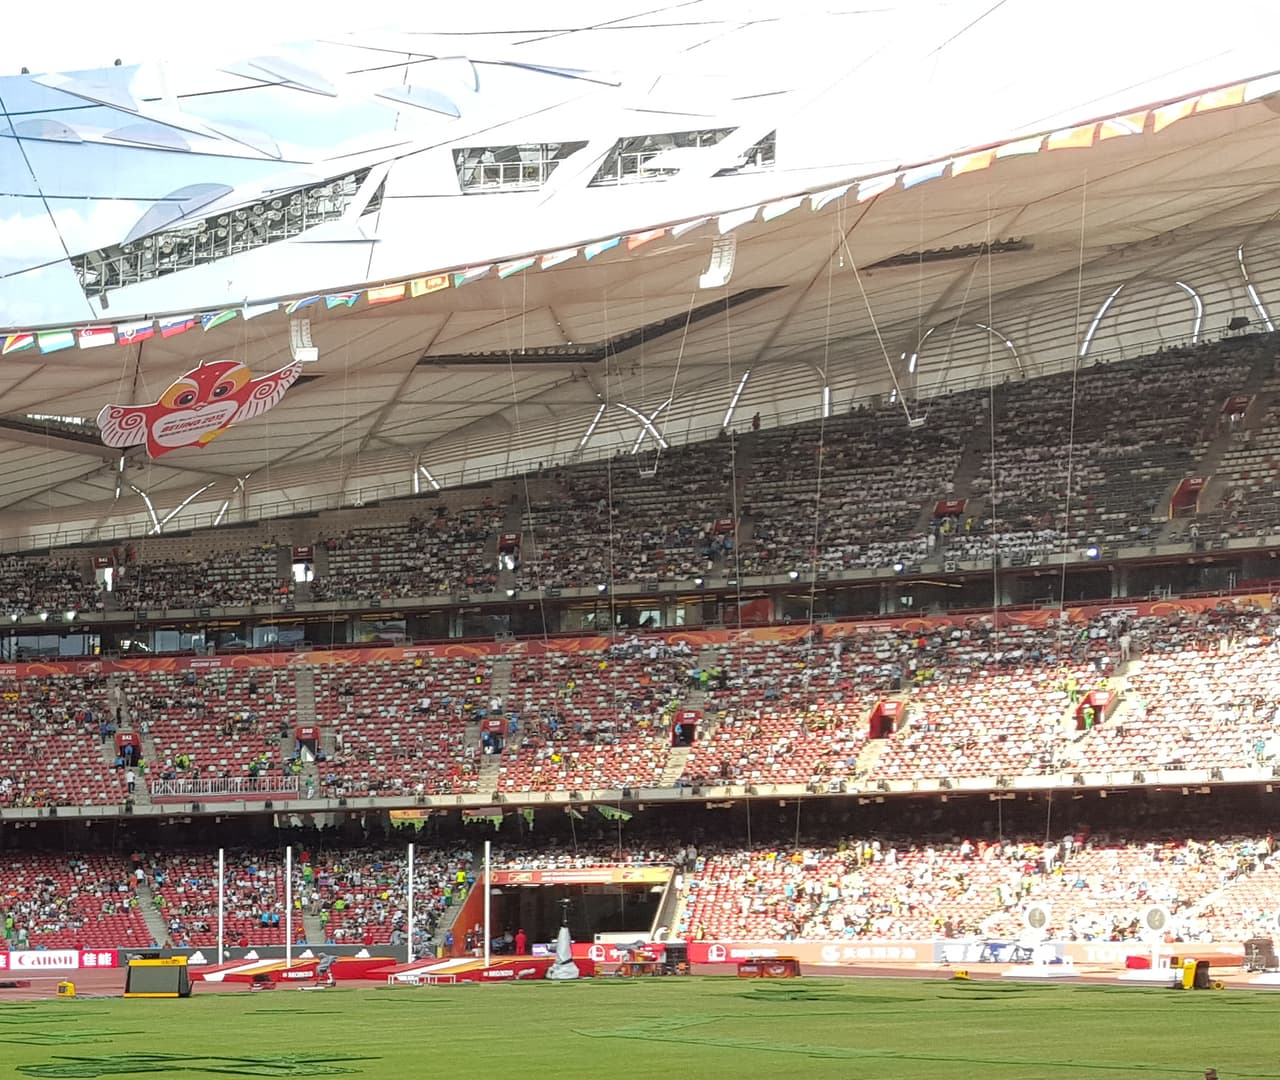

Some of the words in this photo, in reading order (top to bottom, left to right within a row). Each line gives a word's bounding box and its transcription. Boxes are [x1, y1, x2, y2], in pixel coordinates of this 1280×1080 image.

[161, 419, 200, 433] BEIJING
[201, 413, 226, 425] 2015
[18, 953, 73, 966] Canon
[82, 952, 113, 967] 佳能
